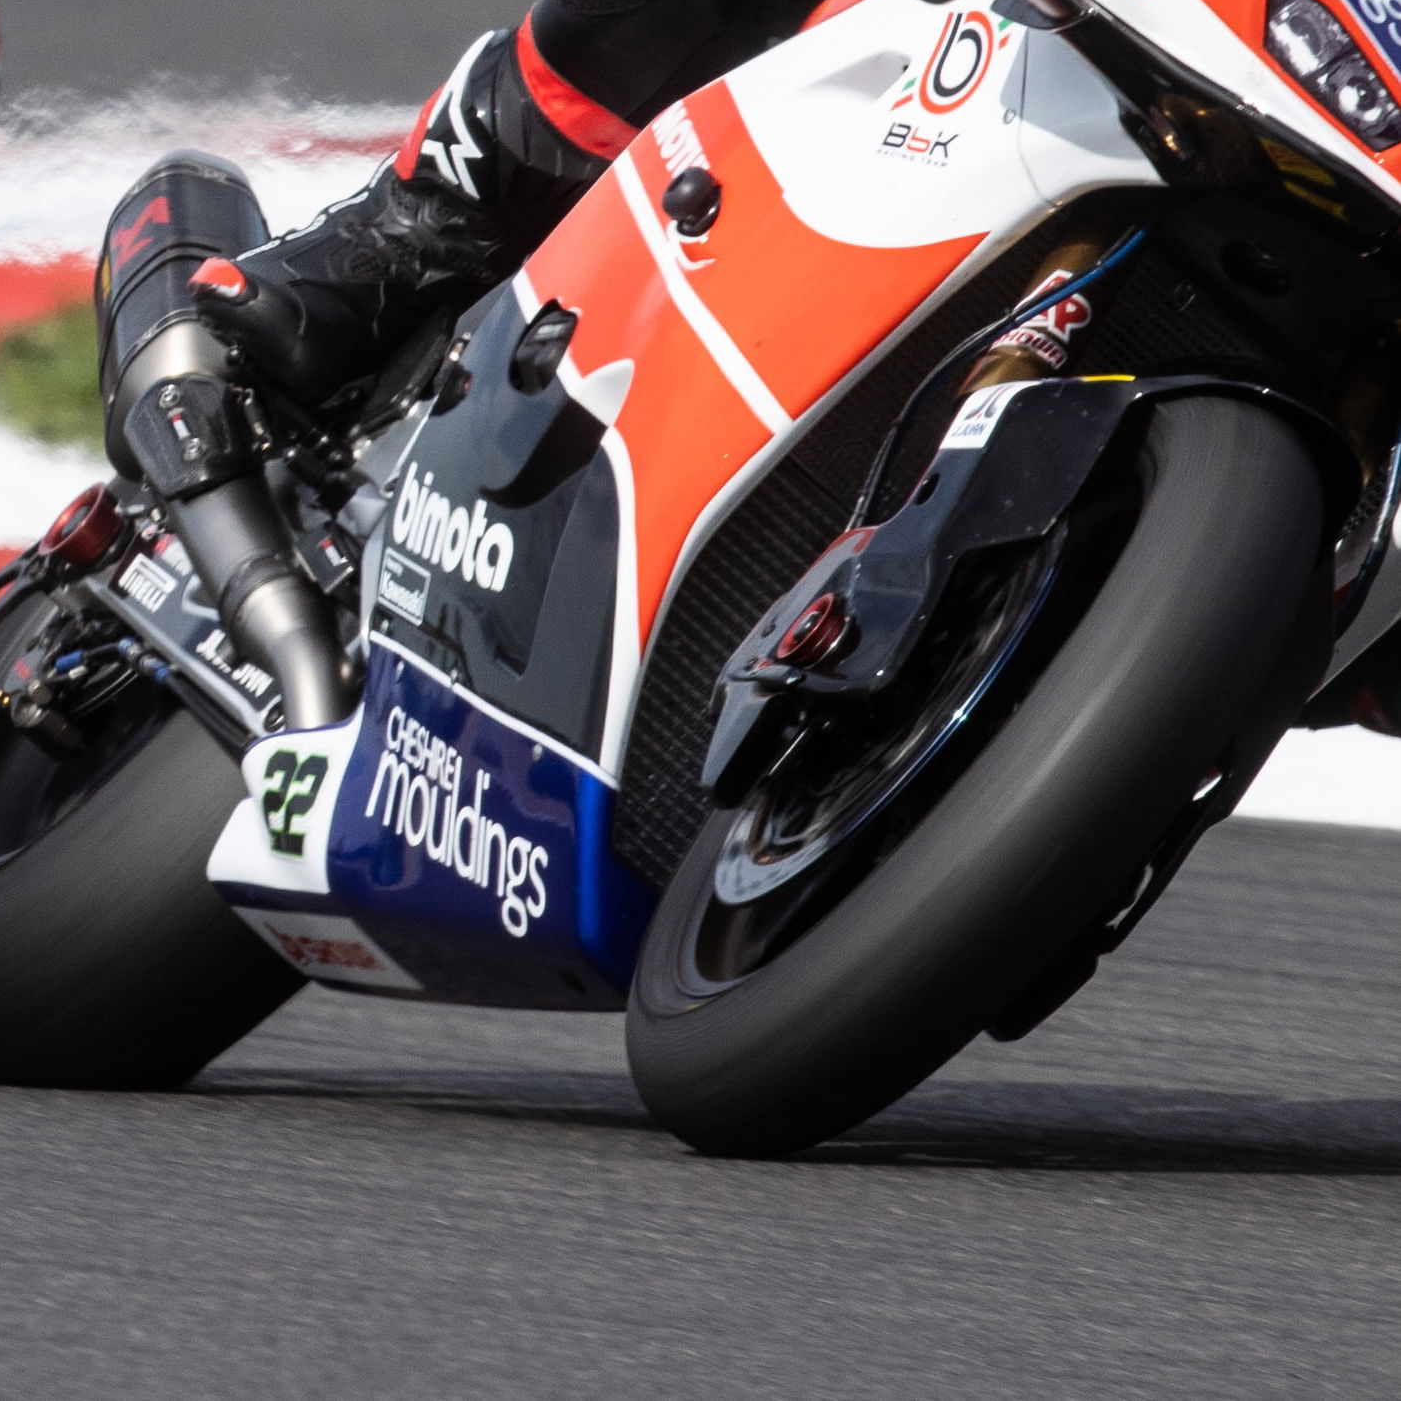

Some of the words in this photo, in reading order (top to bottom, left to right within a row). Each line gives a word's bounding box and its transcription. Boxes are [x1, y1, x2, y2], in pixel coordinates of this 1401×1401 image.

[118, 552, 180, 614] PIRELLI
[393, 461, 515, 593] bimota
[263, 748, 329, 860] 22
[387, 705, 458, 791] CHESHIRE
[365, 750, 549, 938] mouldings
